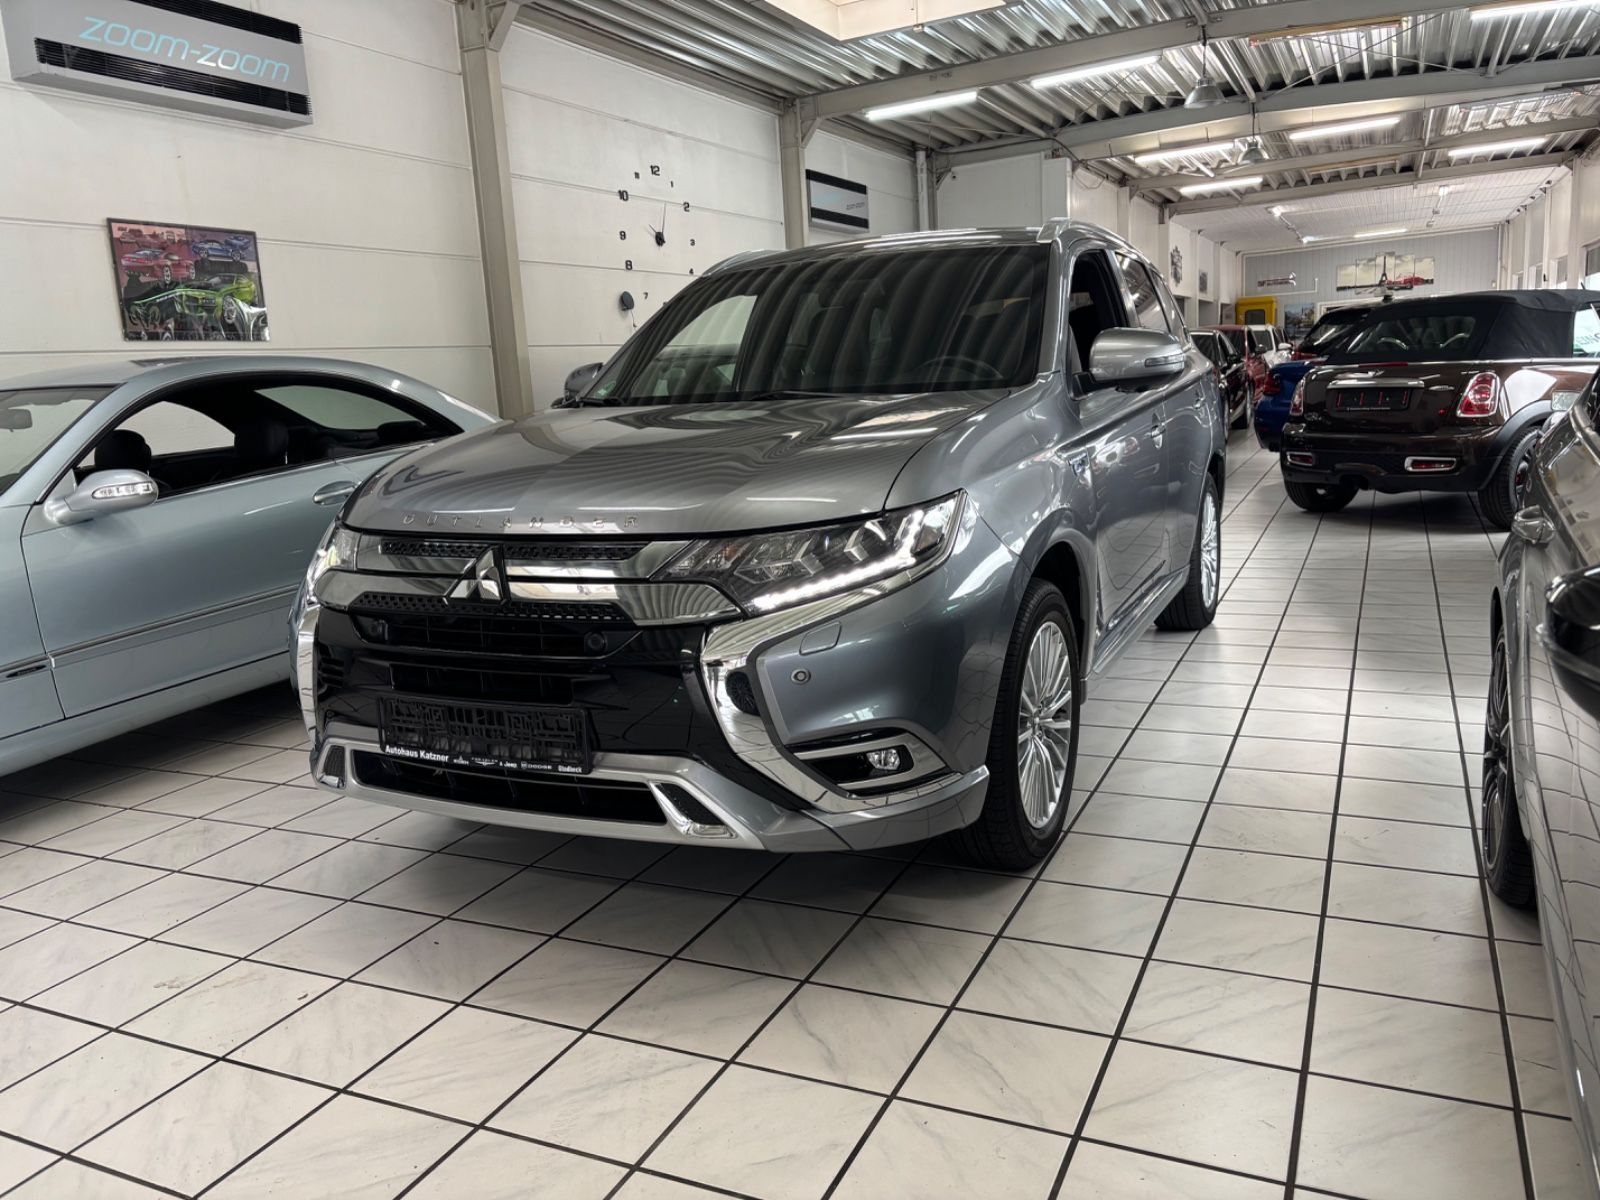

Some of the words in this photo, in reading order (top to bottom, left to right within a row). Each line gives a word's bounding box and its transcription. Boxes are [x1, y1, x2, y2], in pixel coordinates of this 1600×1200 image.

[79, 15, 290, 83] zoom-zoom
[650, 165, 660, 176] 12
[618, 190, 628, 201] 10
[683, 202, 690, 212] 2
[619, 231, 626, 240] 9
[690, 239, 696, 247] 3
[625, 260, 632, 270] 8
[689, 267, 694, 275] 4
[643, 291, 649, 300] 7
[402, 512, 639, 529] OUTLANDER
[385, 745, 418, 758] Autohaus
[419, 750, 449, 762] Katzner
